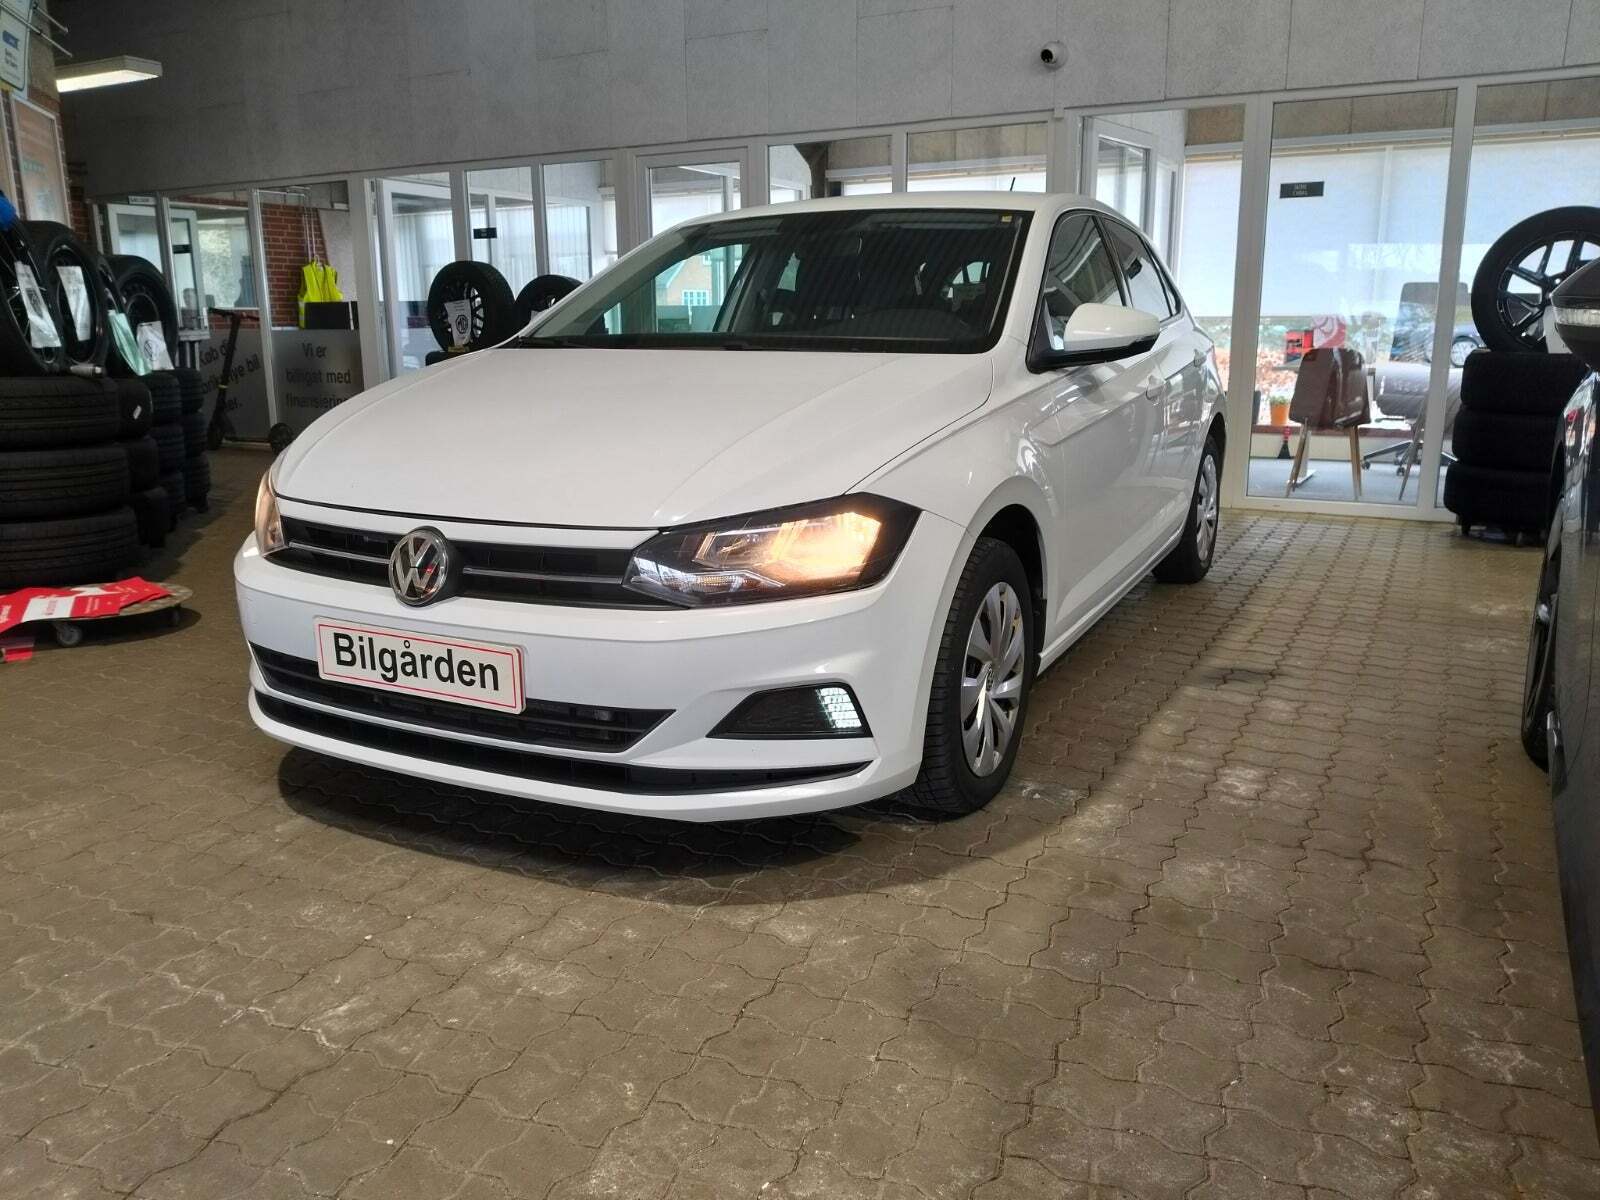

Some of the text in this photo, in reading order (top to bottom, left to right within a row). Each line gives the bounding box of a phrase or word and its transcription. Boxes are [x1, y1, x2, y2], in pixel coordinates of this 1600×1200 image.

[302, 343, 327, 358] Vi er
[326, 369, 352, 384] med
[334, 632, 499, 691] Bilgården
